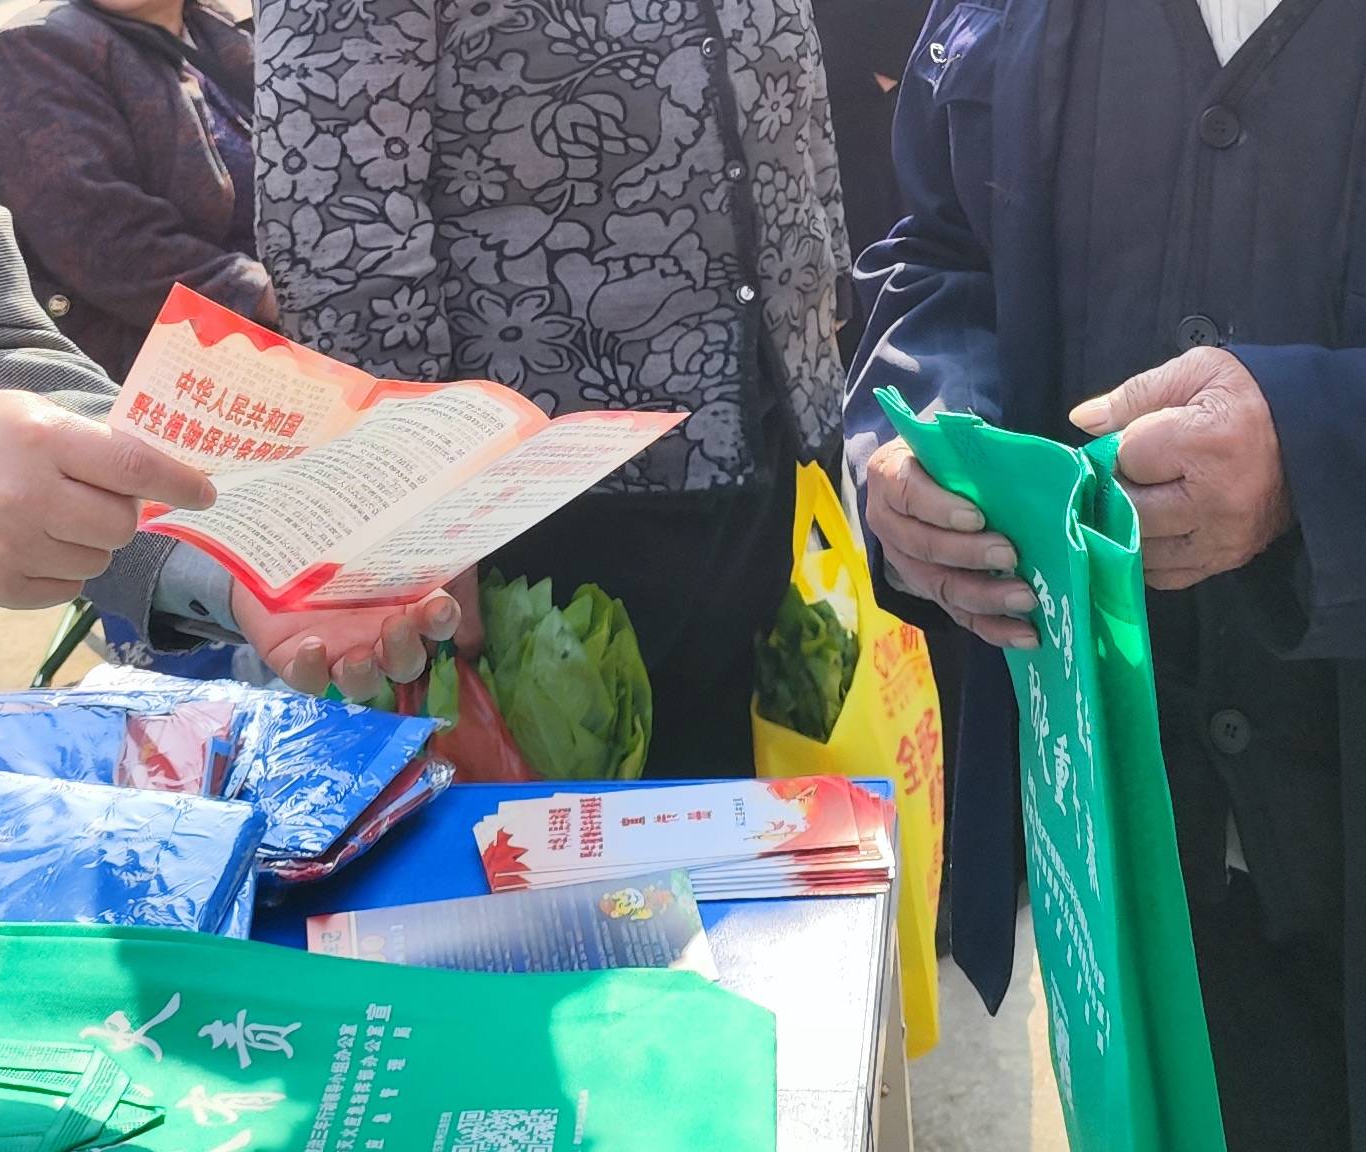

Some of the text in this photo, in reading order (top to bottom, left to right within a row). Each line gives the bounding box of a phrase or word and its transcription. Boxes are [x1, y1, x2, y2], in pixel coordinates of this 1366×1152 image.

[174, 367, 305, 441] 中华人民共和国
[303, 1023, 358, 1152] 治三年行动领导小组办公室
[335, 1024, 384, 1152] 灭火应急指挥部办公室
